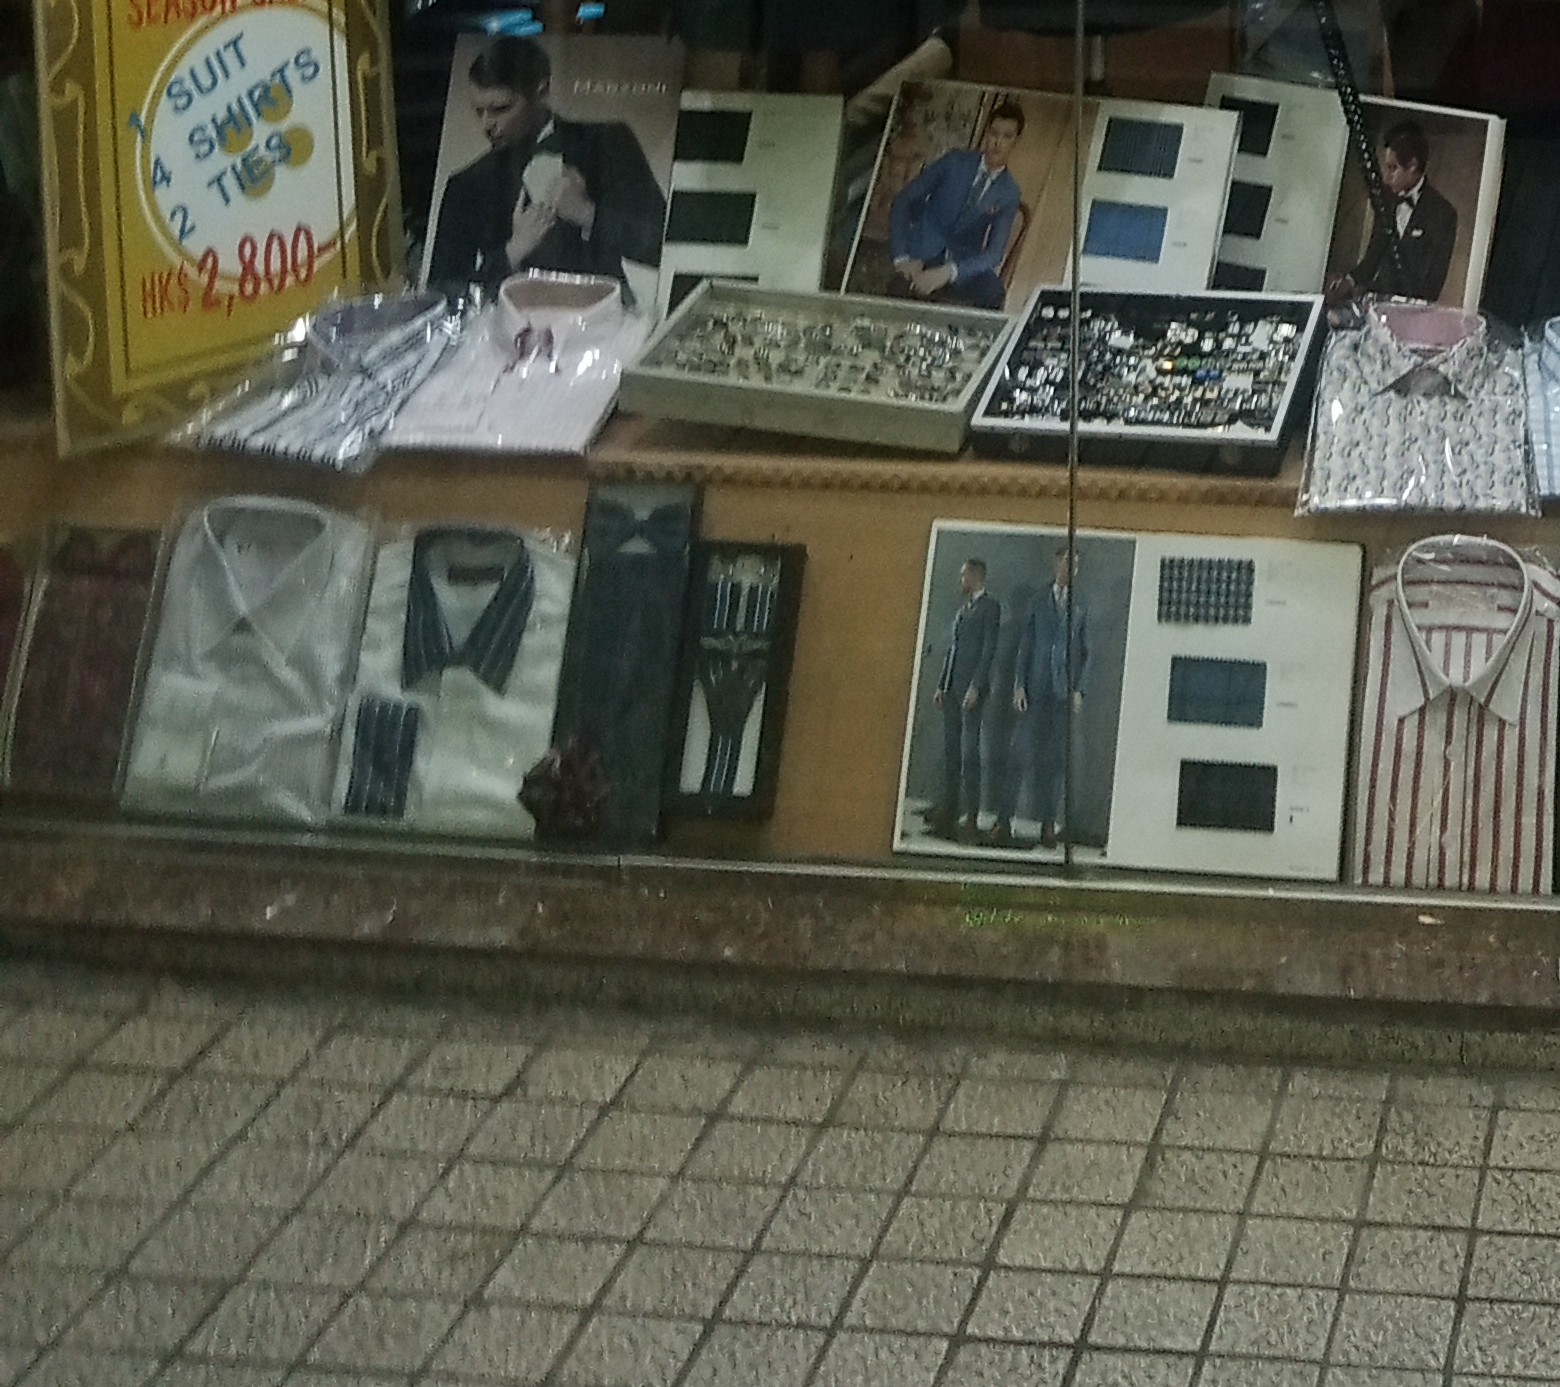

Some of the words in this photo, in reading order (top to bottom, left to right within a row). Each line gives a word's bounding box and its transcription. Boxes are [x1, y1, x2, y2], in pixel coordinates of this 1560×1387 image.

[150, 154, 172, 193] 4
[187, 47, 323, 163] SHIRTS
[165, 31, 250, 115] SUIT
[169, 204, 197, 244] 2
[207, 129, 293, 208] TIES
